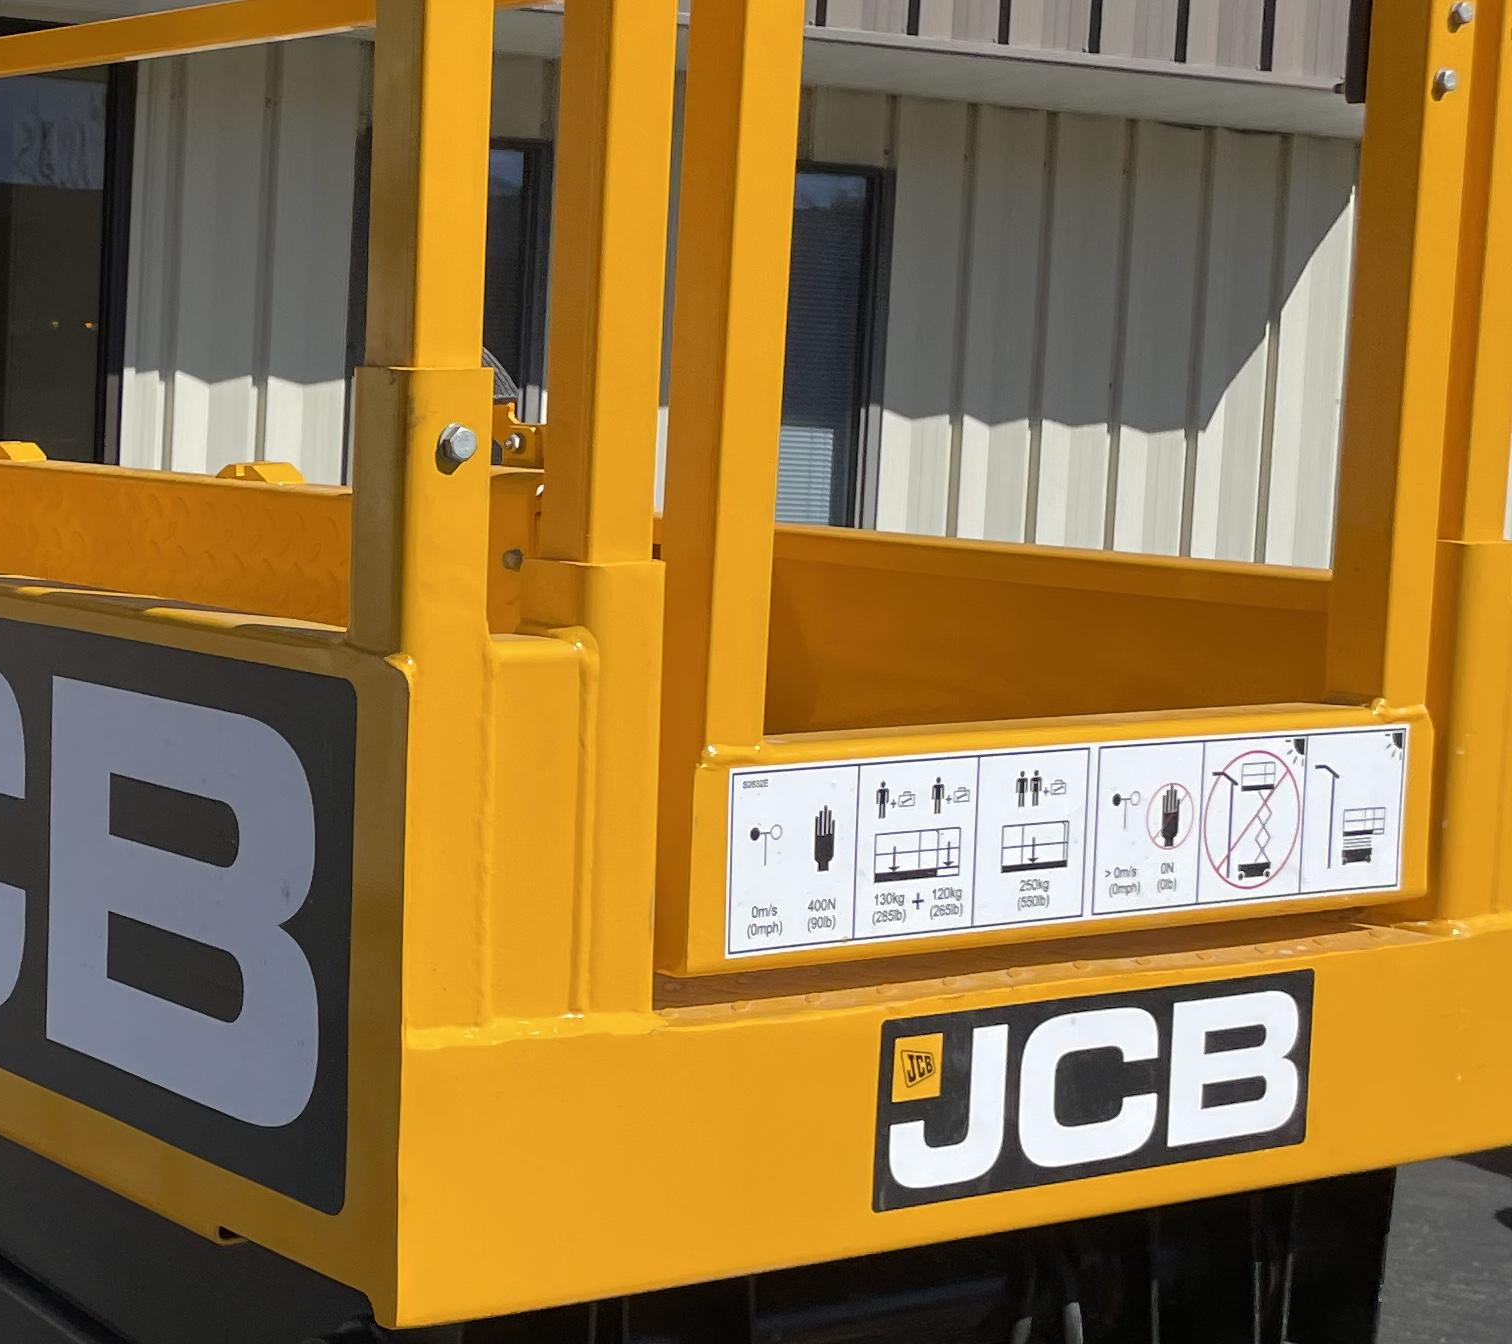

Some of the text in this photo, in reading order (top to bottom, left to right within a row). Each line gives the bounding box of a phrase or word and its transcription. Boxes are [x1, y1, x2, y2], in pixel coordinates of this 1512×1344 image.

[1113, 865, 1137, 879] 0m/s
[1160, 862, 1175, 875] 0N
[1019, 879, 1050, 894] 250kg
[1109, 882, 1140, 898] (0mph)
[1157, 879, 1177, 893] (0lb)
[808, 898, 836, 911] 400N
[874, 893, 906, 909] 130kg
[932, 887, 963, 904] 120kg
[1017, 895, 1050, 910] (550lb)
[751, 906, 778, 919] 0m/s
[747, 922, 783, 939] (0mph)
[807, 915, 836, 932] (90lb)
[906, 1054, 934, 1084] JCB
[889, 990, 1300, 1189] JCB
